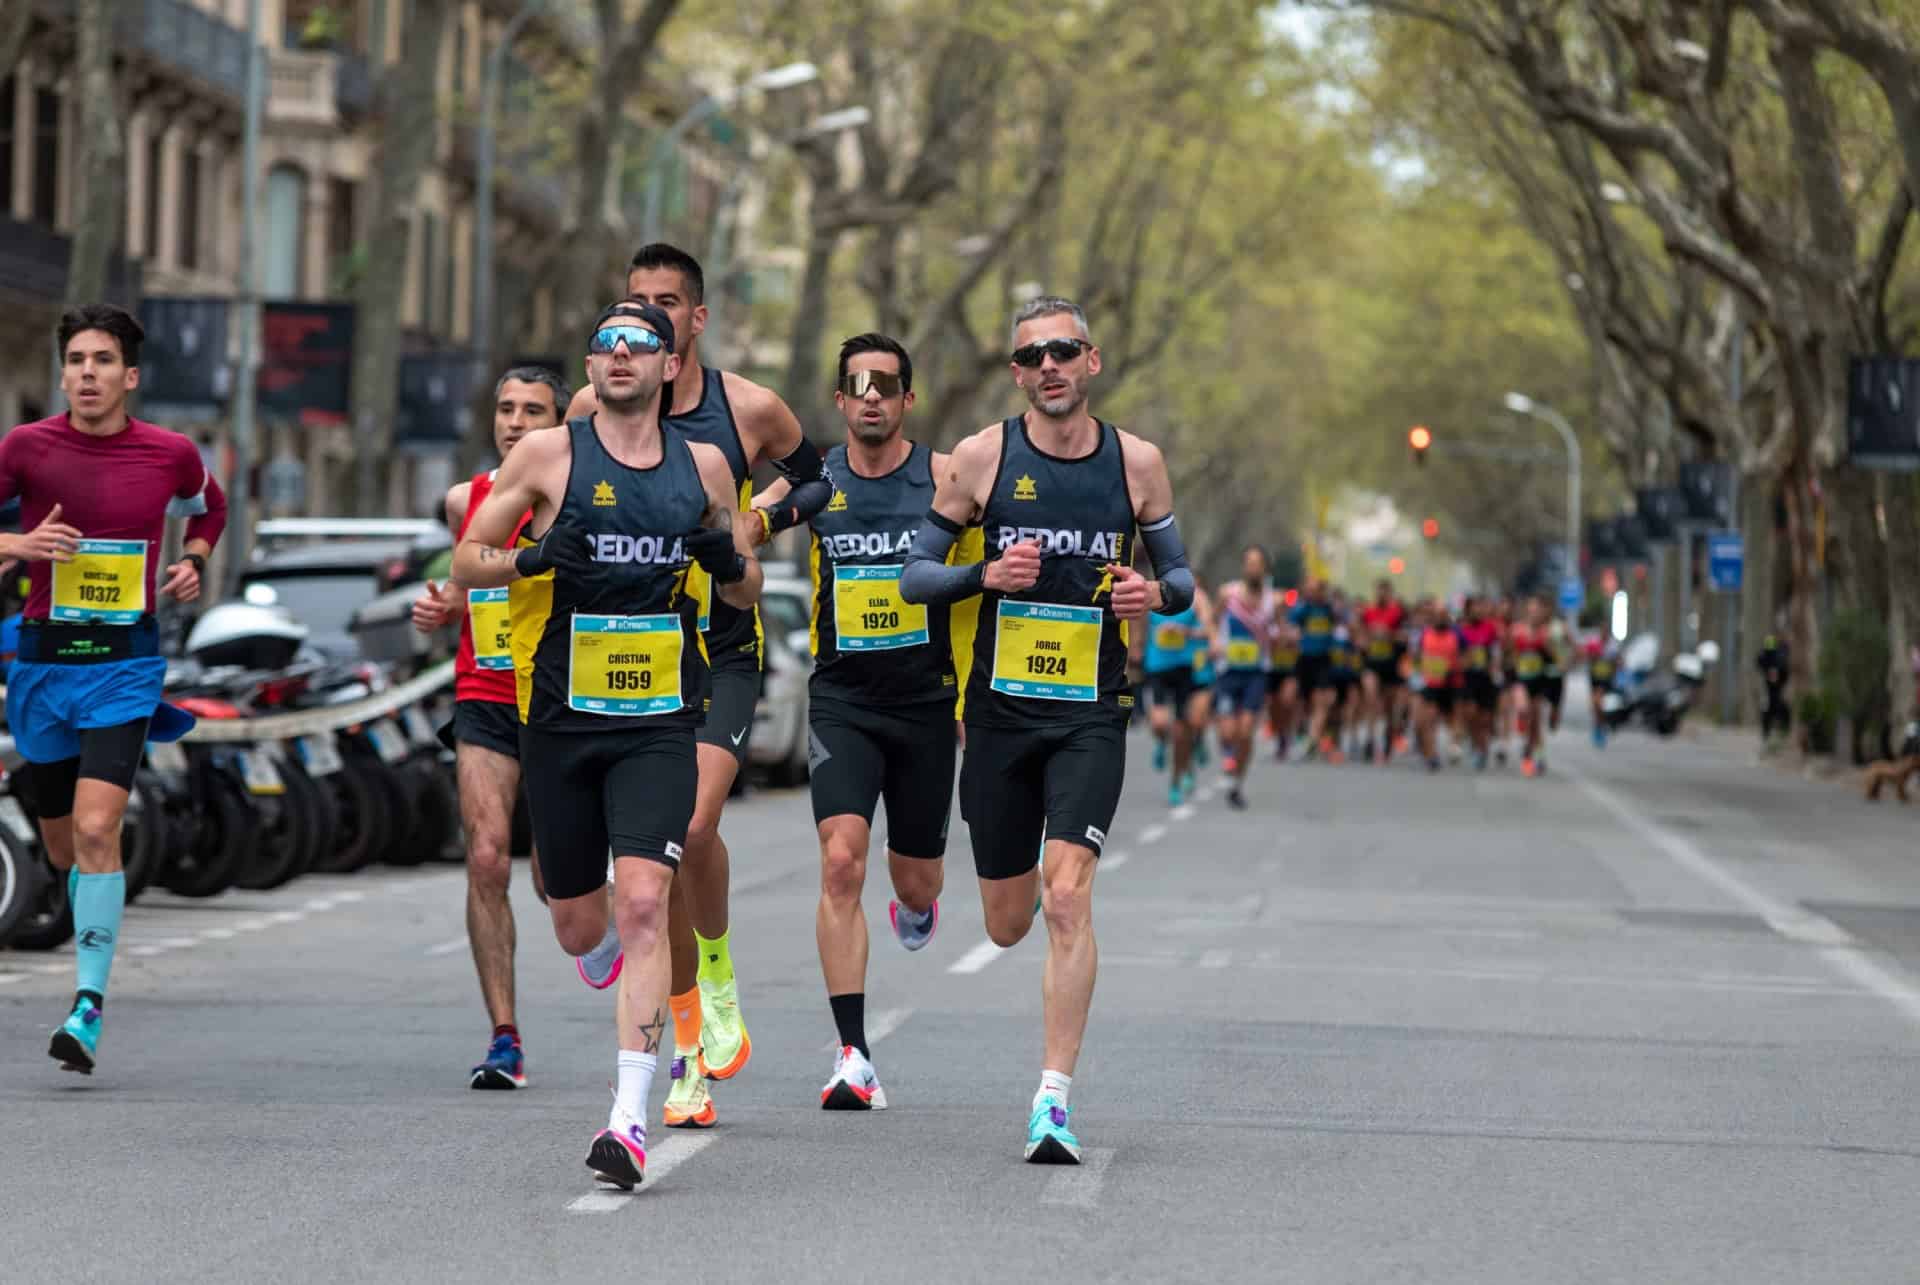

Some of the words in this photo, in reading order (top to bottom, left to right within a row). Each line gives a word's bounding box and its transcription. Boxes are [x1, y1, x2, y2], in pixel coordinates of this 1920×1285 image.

[586, 533, 689, 564] EDOLA
[79, 585, 121, 603] 10372
[861, 611, 899, 629] 1920
[1035, 639, 1062, 651] JORGE
[607, 653, 652, 665] CRISTIAN
[1025, 654, 1068, 676] 1924
[605, 669, 652, 690] 1959
